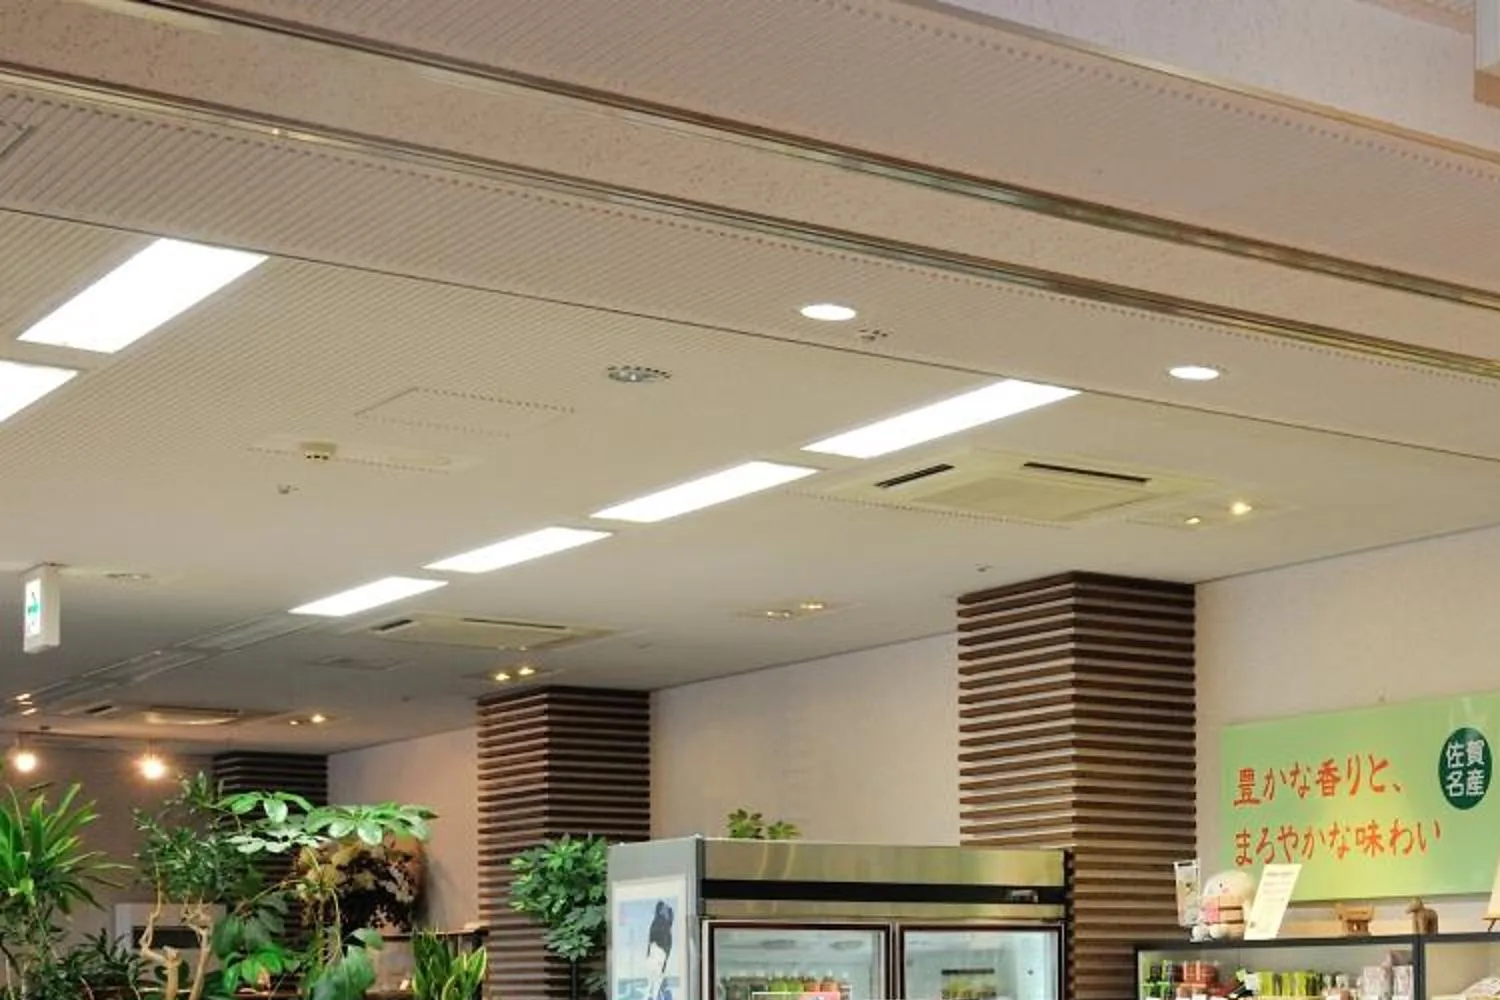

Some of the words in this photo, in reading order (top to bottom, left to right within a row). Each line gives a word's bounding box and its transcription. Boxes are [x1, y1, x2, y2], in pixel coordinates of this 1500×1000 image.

[1444, 737, 1487, 768] 佐賀
[1233, 752, 1404, 808] 豊かな香りと、
[1444, 769, 1487, 799] 名産
[1234, 819, 1441, 867] まろやかな味わい
